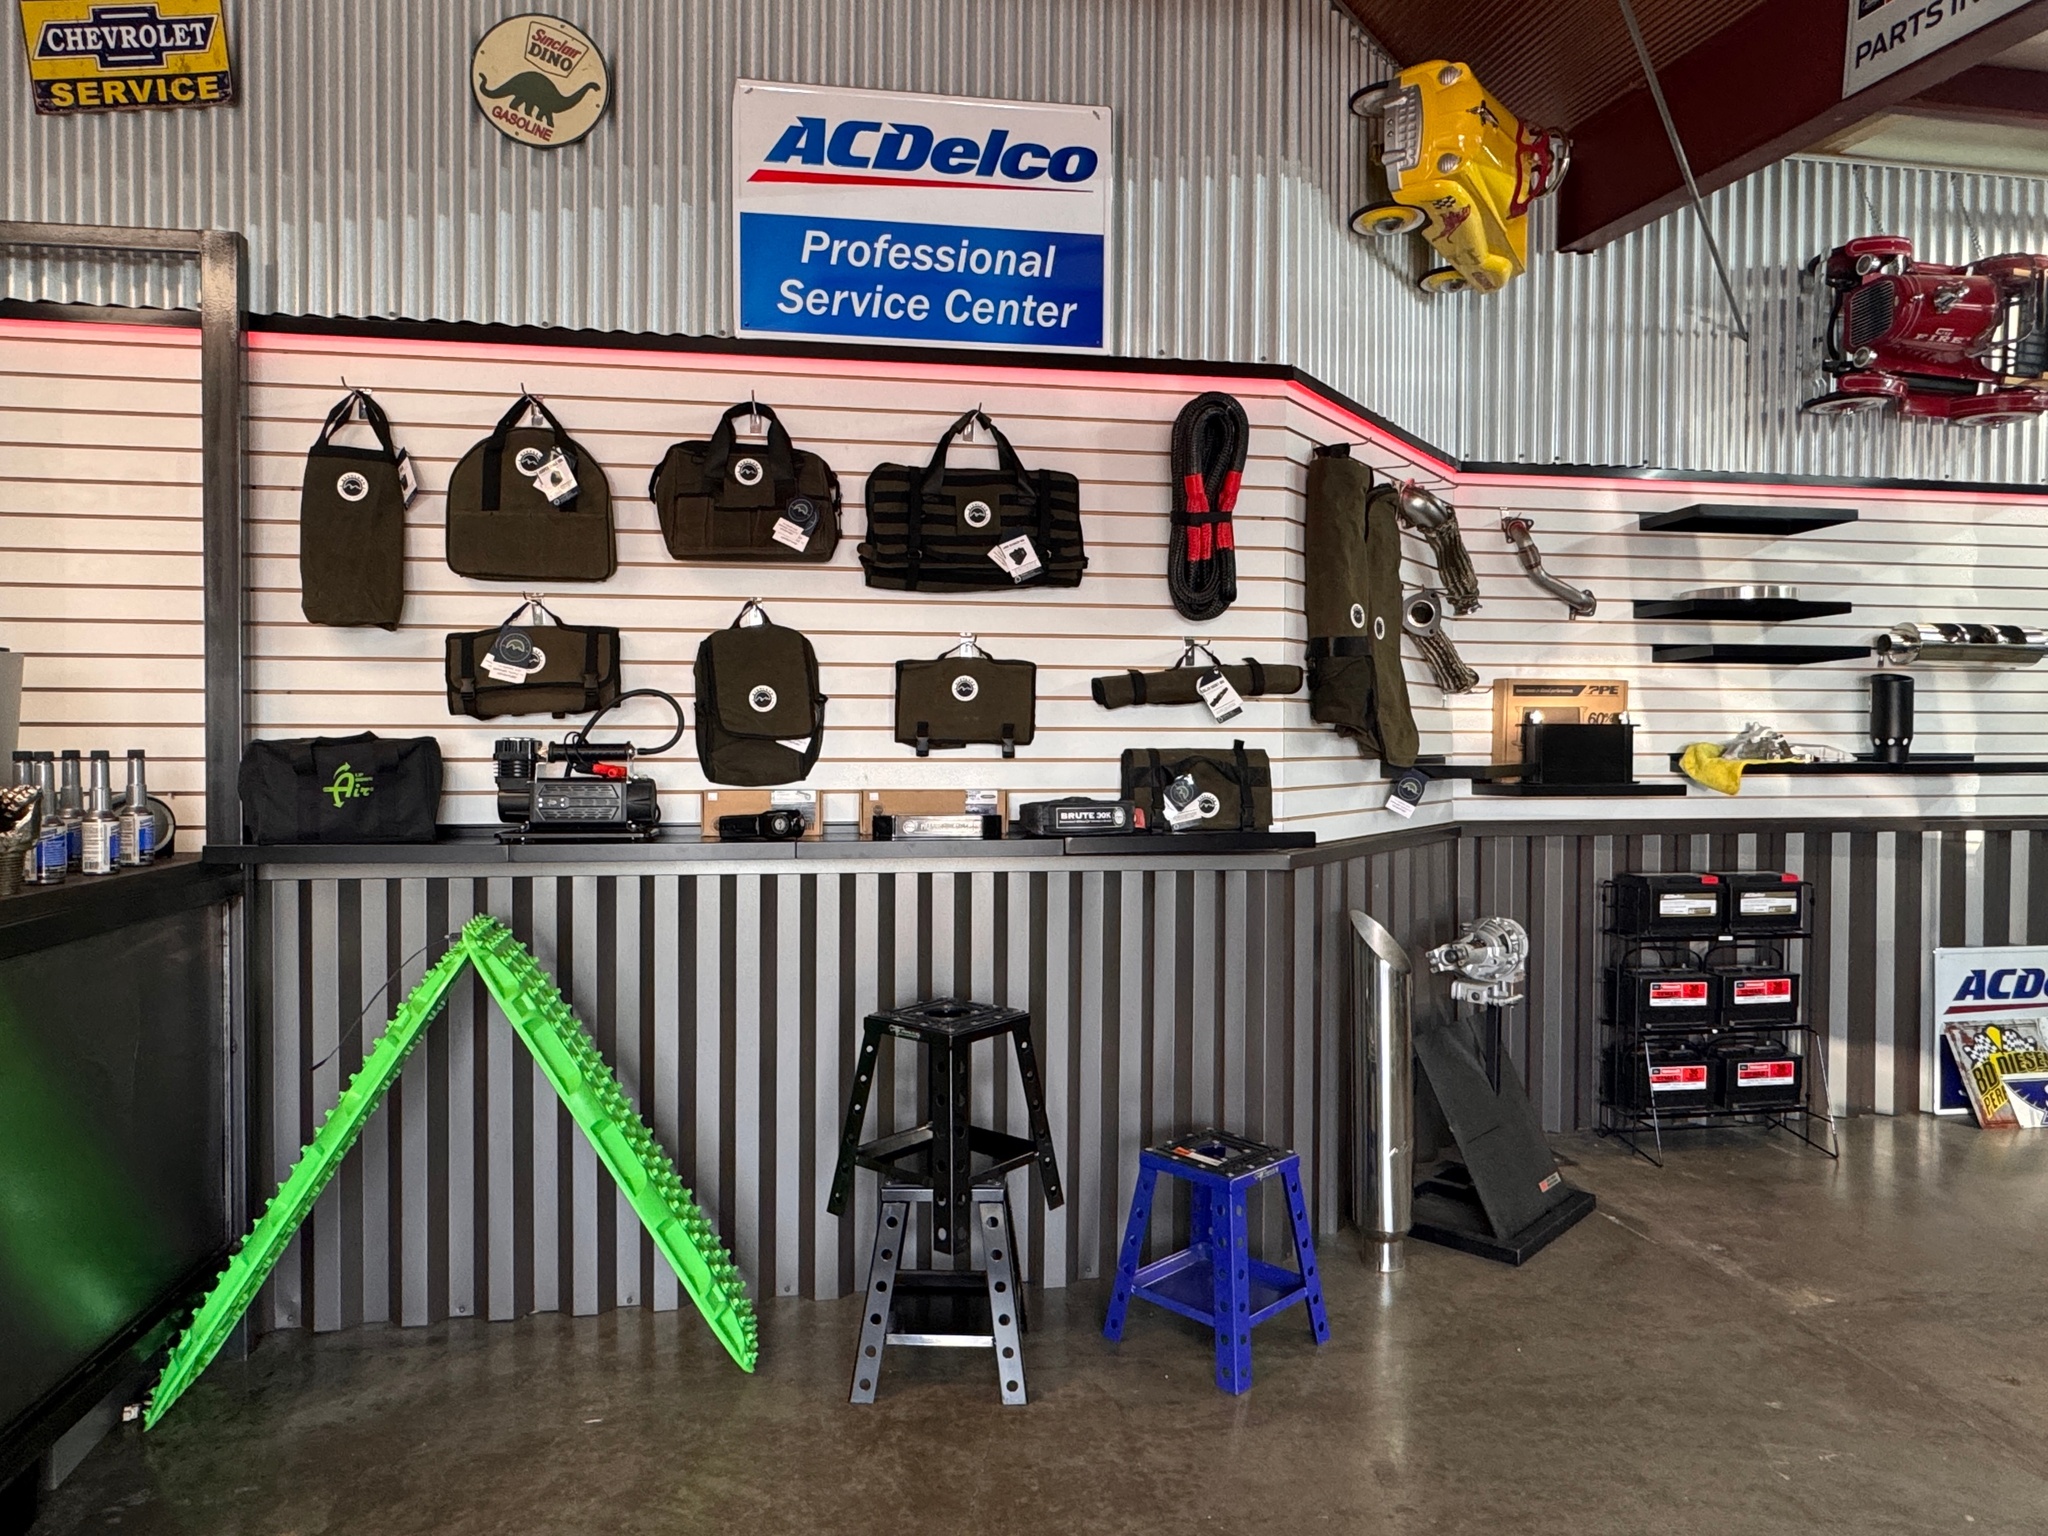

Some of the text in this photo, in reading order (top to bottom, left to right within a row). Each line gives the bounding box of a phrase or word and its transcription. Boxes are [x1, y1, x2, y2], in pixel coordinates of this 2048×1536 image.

[46, 22, 207, 52] CHEVROLET
[531, 28, 582, 59] Sinclair
[1855, 0, 1981, 69] PARTS I
[527, 41, 573, 72] DINO
[50, 75, 220, 107] SERVICE
[491, 105, 554, 142] GASOLINE
[763, 115, 1099, 183] ACDelco
[801, 229, 1056, 279] Professional
[776, 278, 1078, 329] Service Center
[1913, 333, 1965, 343] FIRE
[323, 770, 375, 808] Air
[1060, 811, 1112, 820] BRUTE 30K
[1953, 967, 2048, 1001] ACD
